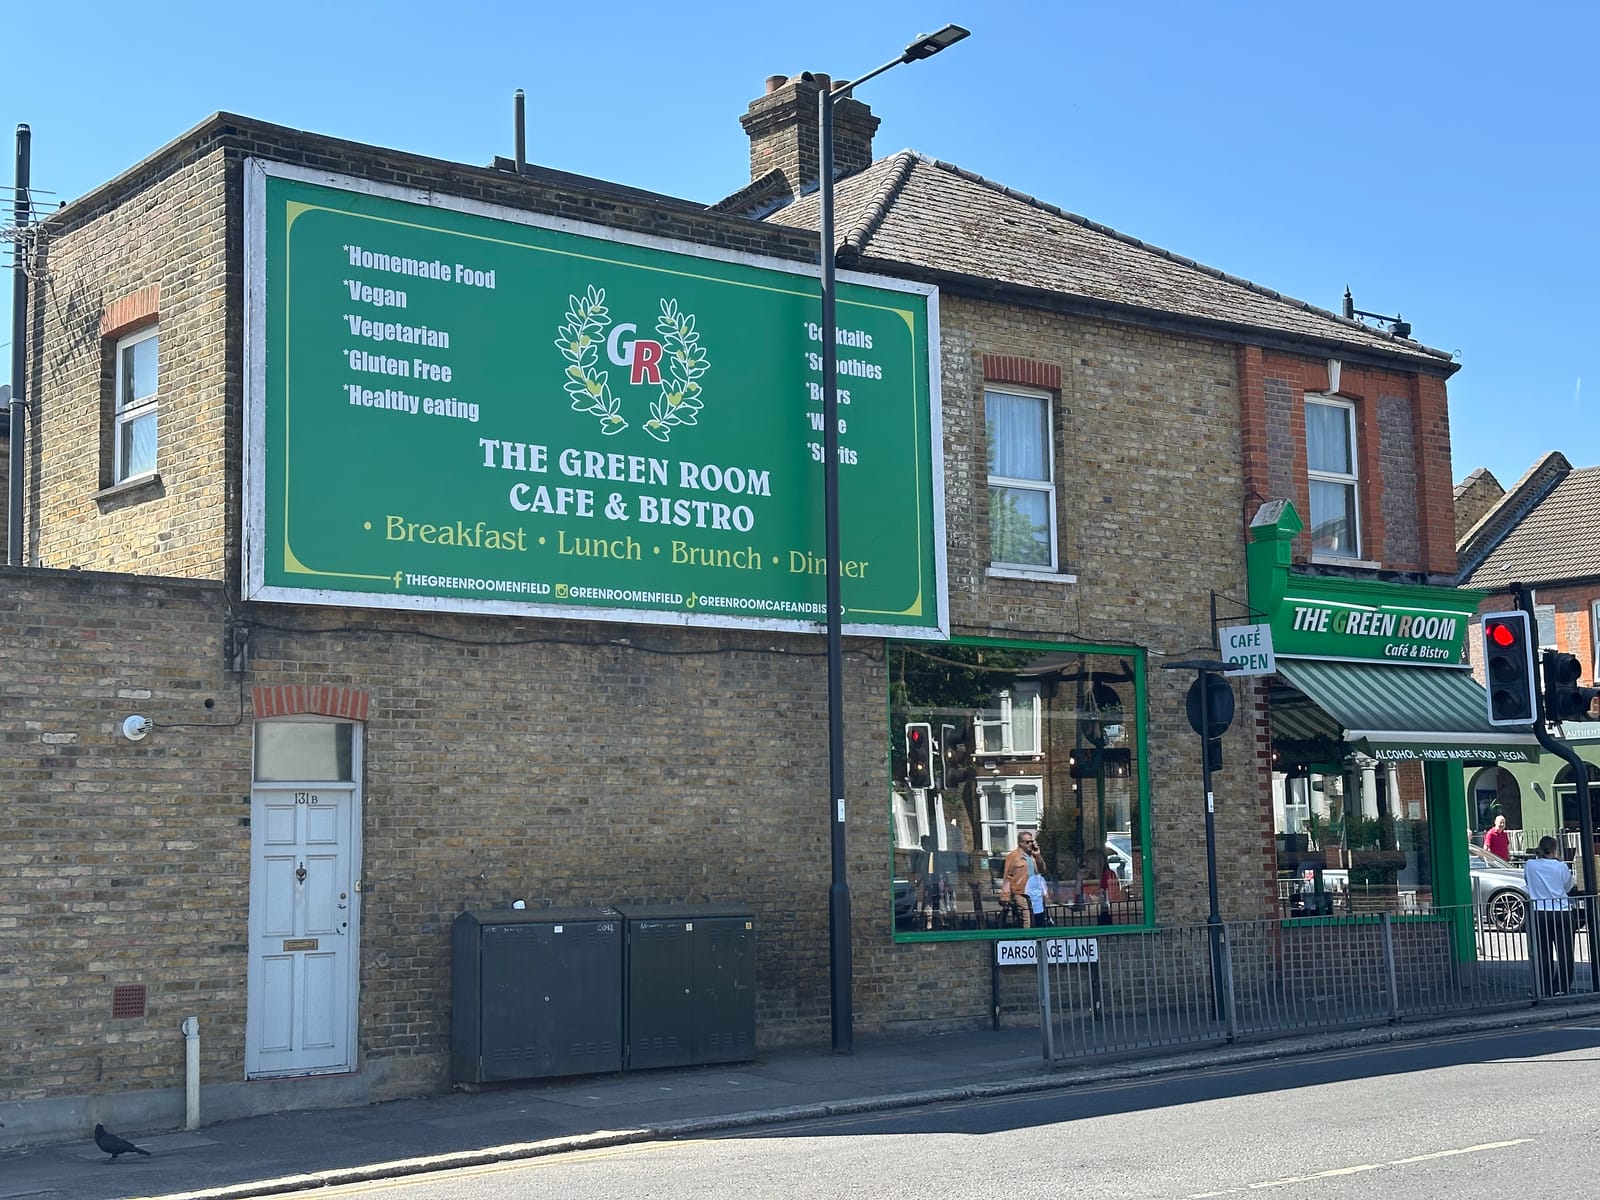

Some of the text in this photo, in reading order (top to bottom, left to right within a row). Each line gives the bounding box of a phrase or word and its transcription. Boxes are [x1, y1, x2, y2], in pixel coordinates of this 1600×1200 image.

[455, 263, 495, 289] Food
[803, 322, 873, 349] Coktails
[413, 358, 452, 382] Free
[423, 397, 479, 422] eating
[479, 437, 771, 497] THE GREEN ROOM
[509, 483, 755, 532] CAFE & BISTRO
[386, 515, 527, 552] Breakfast
[558, 530, 642, 561] Lunch
[671, 540, 762, 570] Brunch
[405, 573, 550, 595] THEGREENROOMENFIELD
[569, 586, 683, 605] GREENROOMENFIELD
[699, 595, 846, 616] GREENROOMCAFEANDBISO
[1293, 606, 1456, 641] THE GREEN ROOM
[1385, 643, 1409, 657] Café
[1410, 646, 1418, 657] &
[1419, 647, 1450, 660] Bistro
[1375, 749, 1418, 760] ALCOHOL
[1424, 750, 1447, 759] HOME
[1449, 750, 1475, 759] MADE
[1474, 751, 1496, 760] FOOD
[295, 792, 319, 804] 131 B
[1001, 944, 1095, 960] PARSOGE LANE
